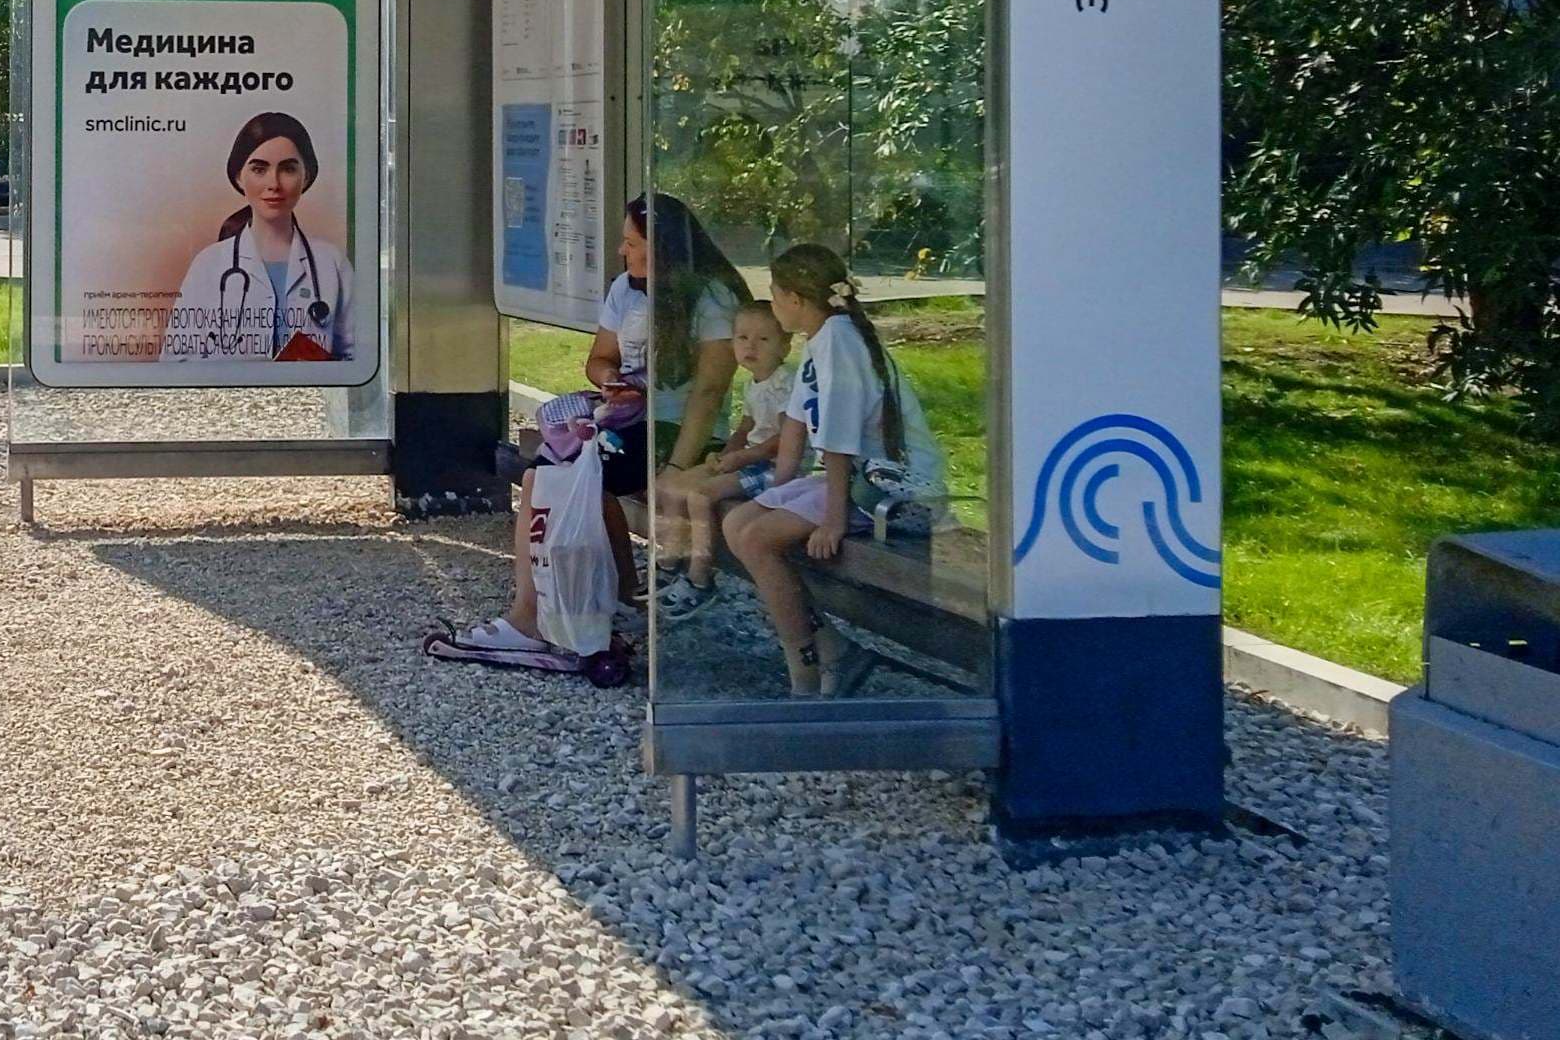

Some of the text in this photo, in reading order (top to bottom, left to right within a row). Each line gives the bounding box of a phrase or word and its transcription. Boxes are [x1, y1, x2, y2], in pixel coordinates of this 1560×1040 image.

[85, 27, 255, 56] Медицина
[85, 69, 294, 94] для каждого
[85, 114, 187, 133] smclinic.ru
[82, 307, 136, 329] ИМЕЮТСЯ
[253, 307, 329, 329] НЕОБХОДИ
[82, 333, 219, 356] ПРОКОНСУЛЬТИРОВАТЬСЯ
